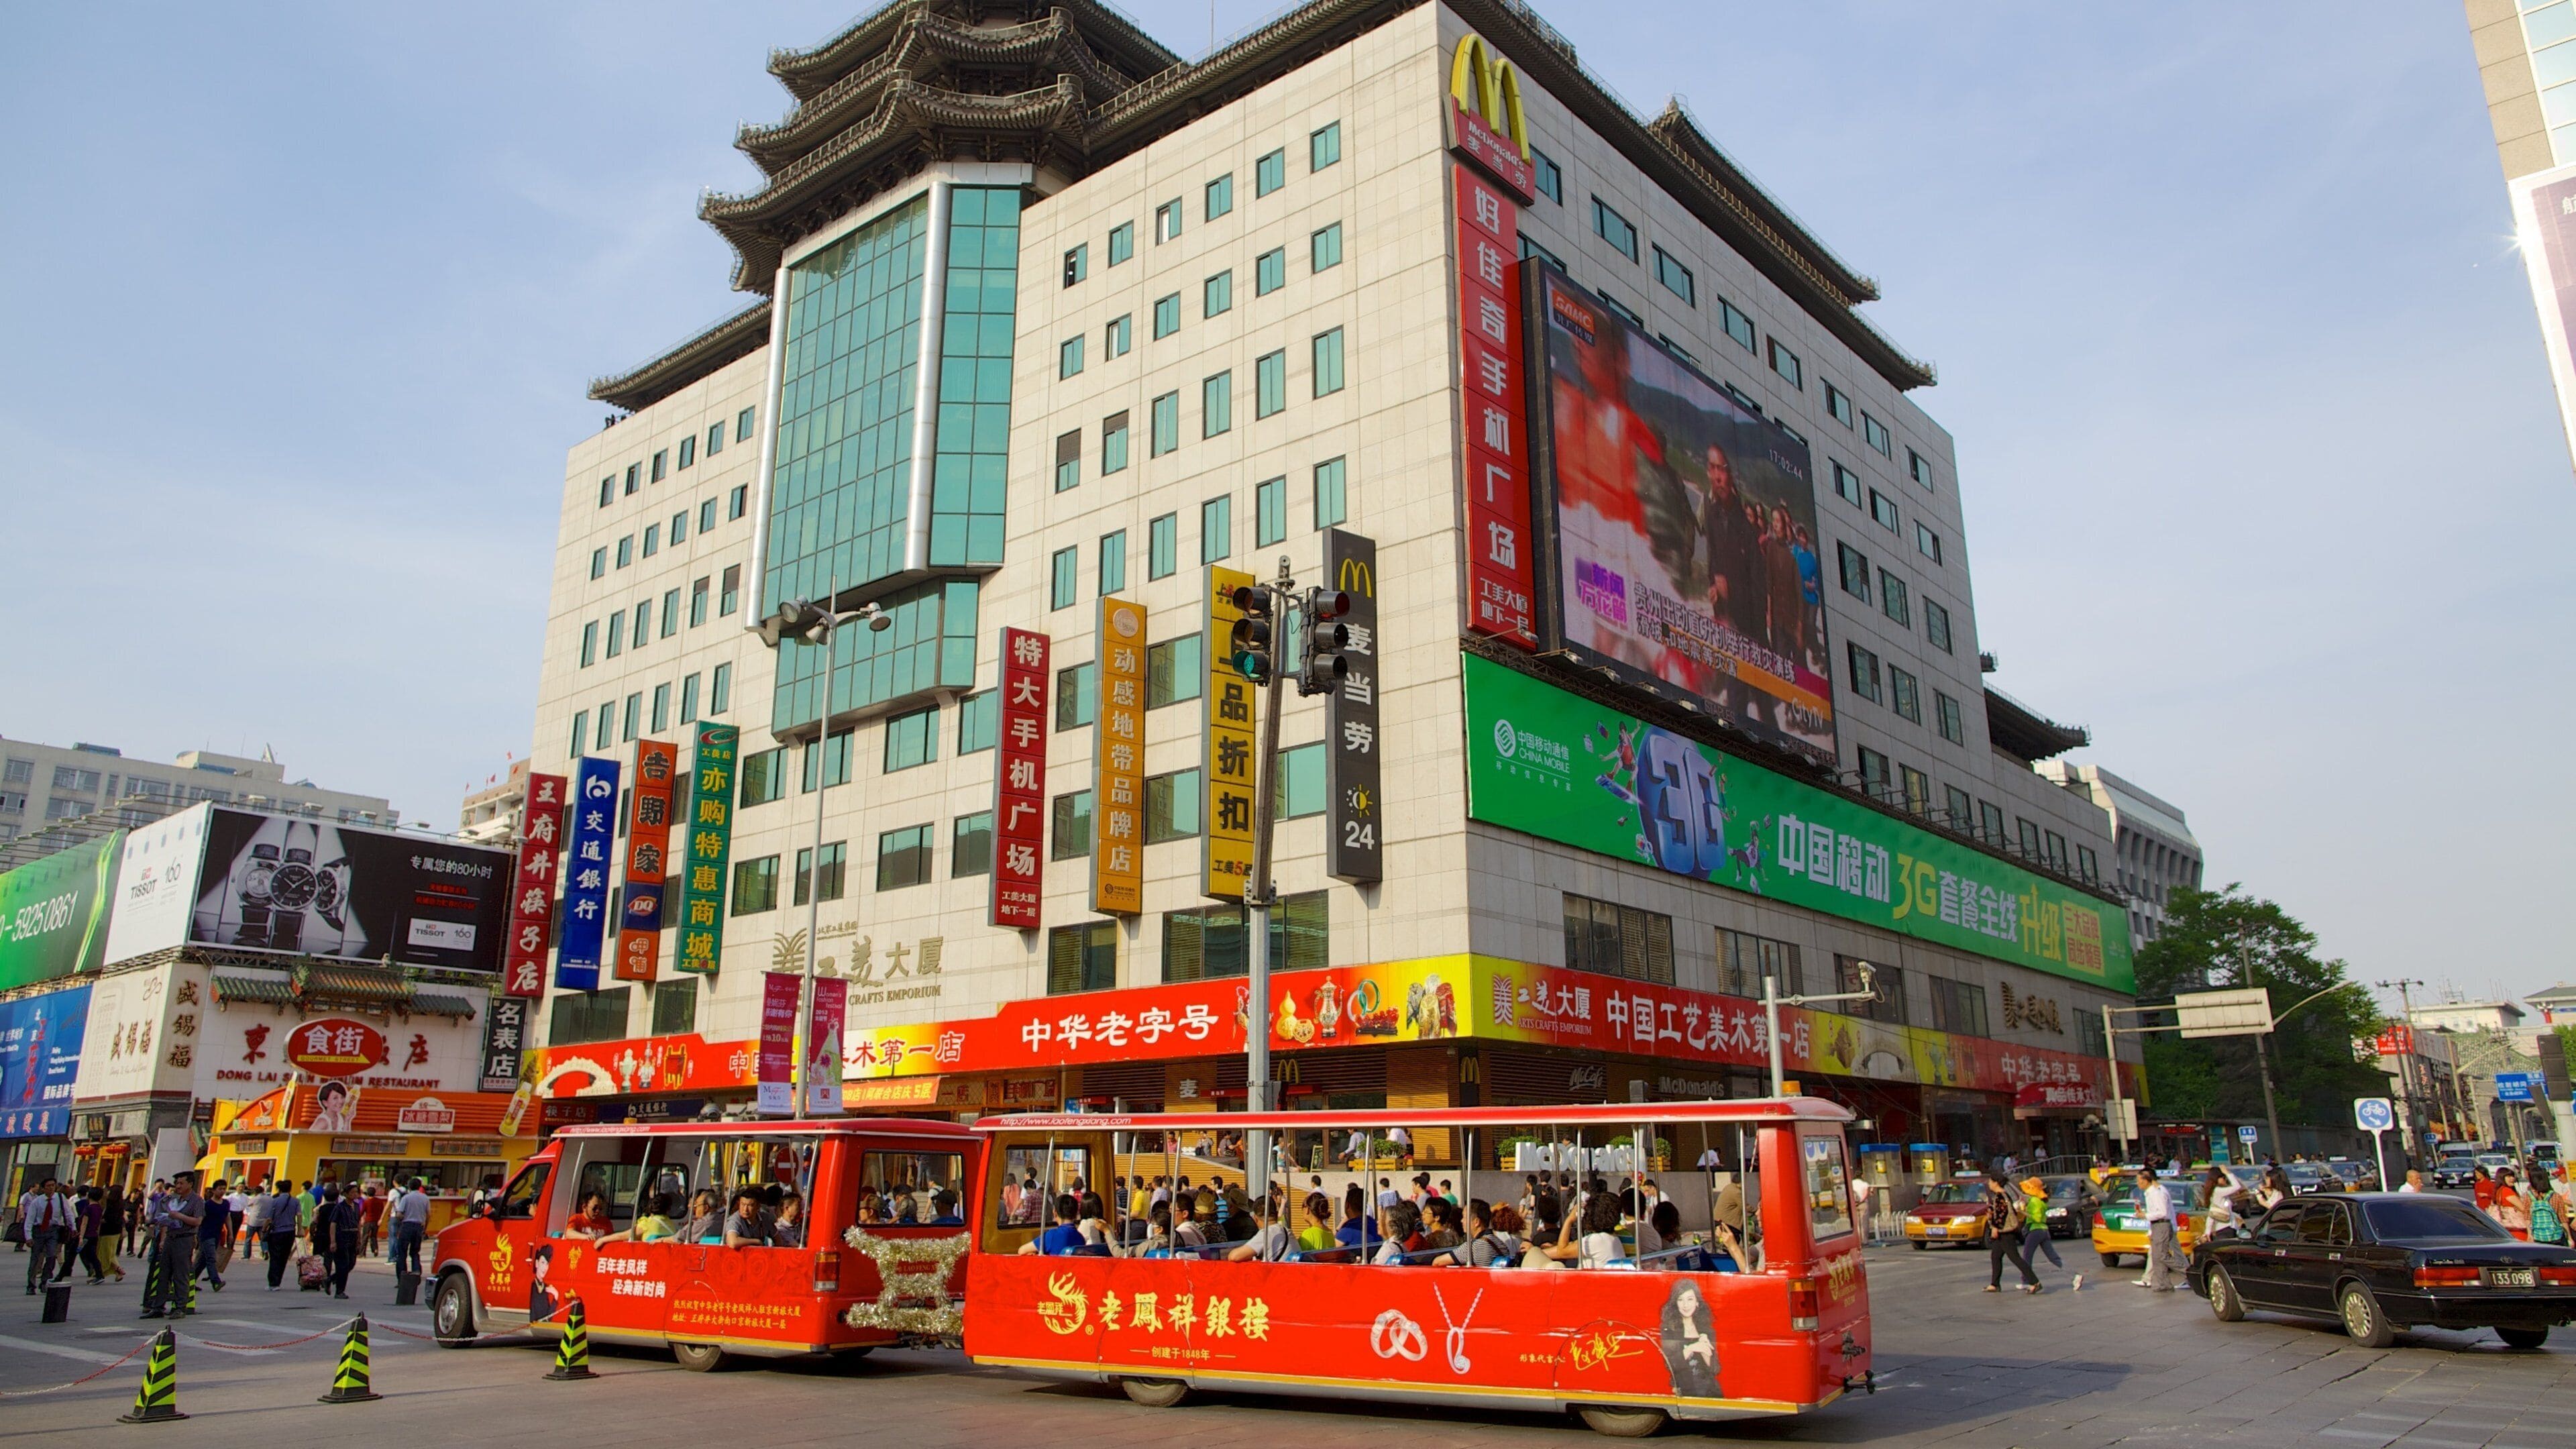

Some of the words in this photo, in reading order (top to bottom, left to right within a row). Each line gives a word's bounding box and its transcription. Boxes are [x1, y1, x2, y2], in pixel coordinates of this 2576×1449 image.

[1468, 121, 1525, 171] McDonald's
[1467, 135, 1527, 190] 麦当劳
[1475, 186, 1515, 570] 好佳奇手机广场
[1770, 449, 1803, 481] 17:02:44
[1480, 577, 1528, 614] 工美大厦
[1006, 635, 1043, 877] 特大手机广场
[1517, 730, 1569, 760] 中国移动通信
[1110, 647, 1136, 873] 动感地带品牌店
[1519, 747, 1544, 764] CHINA
[1544, 755, 1570, 773] MOBILE
[1345, 820, 1375, 851] 24
[410, 855, 492, 879] 专属您的80小时
[687, 768, 728, 960] 亦购特惠商城
[131, 879, 157, 899] TISSOT
[512, 781, 557, 992] 王府井筷子店
[1002, 891, 1036, 904] 工美大厦
[633, 899, 654, 912] DQ
[1001, 904, 1035, 917] 地下一层
[415, 928, 445, 936] TISSOT
[848, 991, 883, 1006] CRAFTS
[887, 985, 941, 1002] EMPORIUM
[1022, 1004, 1219, 1053] 中华老字号
[1518, 1017, 1534, 1029] ARTS
[1535, 1019, 1558, 1032] CRAFTS
[1560, 1022, 1592, 1035] EMPORIUM
[304, 1025, 364, 1055] 食街
[490, 1002, 521, 1077] 名表店
[217, 1070, 252, 1081] DONG
[258, 1072, 276, 1082] LAI
[368, 1077, 440, 1088] RESTAURANT
[1179, 1079, 1198, 1098] 麦
[1659, 1076, 1724, 1097] McDonald's
[404, 1112, 451, 1123] 冰糖雪梨
[597, 1257, 648, 1277] 百年老凤祥
[2492, 1273, 2510, 1285] 133
[2512, 1273, 2532, 1285] 098
[612, 1279, 665, 1299] 经典新时尚
[1097, 1290, 1271, 1342] 老鳳祥銀樓
[1151, 1346, 1211, 1361] 创建于1848年
